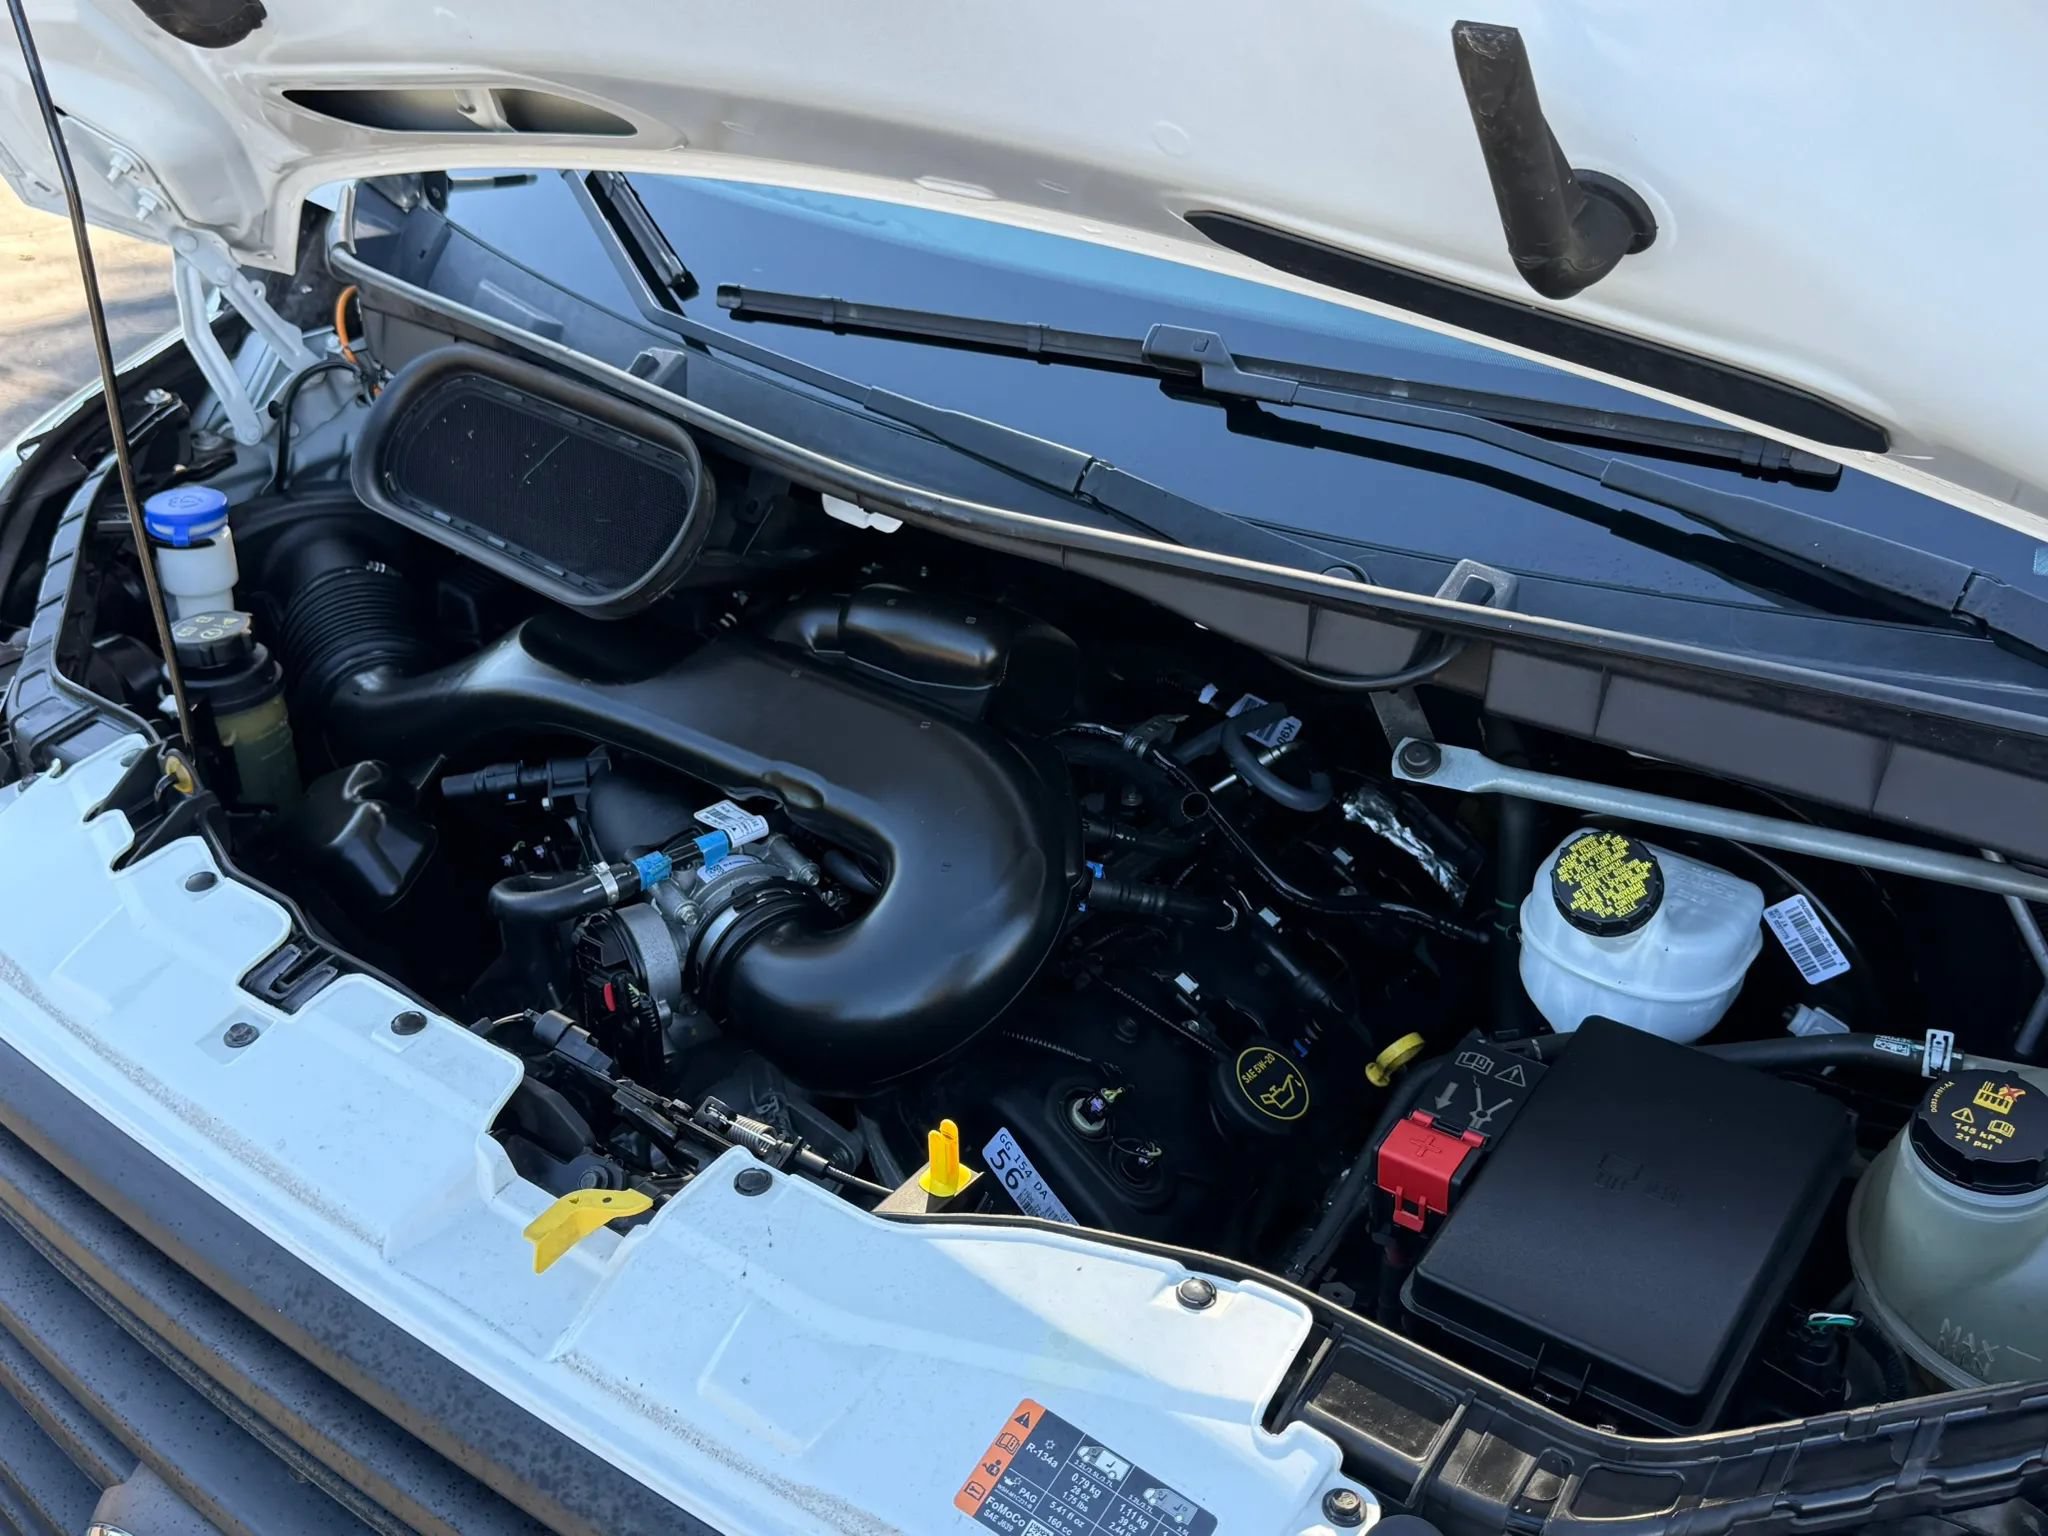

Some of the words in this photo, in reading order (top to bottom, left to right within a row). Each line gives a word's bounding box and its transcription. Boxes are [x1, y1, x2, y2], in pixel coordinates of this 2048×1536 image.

[1557, 860, 1579, 875] BEFORE
[1610, 836, 1623, 845] USE
[1559, 852, 1579, 865] CLEAN
[1579, 841, 1599, 854] FILLER
[1599, 833, 1612, 843] CAP
[1559, 871, 1575, 882] ONLY
[1575, 863, 1587, 873] DOT
[1594, 850, 1612, 862] FLUID
[1612, 840, 1630, 853] FROM
[1573, 867, 1596, 882] SEALED
[1616, 883, 1626, 891] DU
[1570, 896, 1589, 909] AVANT
[1589, 890, 1598, 898] DE
[1592, 903, 1605, 913] DOT
[1241, 1068, 1257, 1084] SAE
[1253, 1053, 1276, 1073] 5W-20
[1955, 1123, 1977, 1135] 145
[1979, 1131, 2003, 1144] kPa
[1955, 1132, 1970, 1142] 21
[1973, 1140, 1993, 1151] psi
[990, 1148, 1025, 1190] 56
[1000, 1133, 1013, 1151] GG
[1014, 1154, 1033, 1178] 154
[1033, 1181, 1048, 1200] DA
[1940, 1317, 1999, 1362] MAX
[1026, 1442, 1058, 1468] R-134a
[1018, 1487, 1038, 1503] PAG
[1070, 1485, 1081, 1495] 28
[1080, 1493, 1091, 1502] oz
[1071, 1473, 1090, 1489] 0.79
[1089, 1484, 1102, 1499] kg
[985, 1495, 1026, 1527] FoMoCo
[1062, 1491, 1077, 1505] 1.75
[1076, 1500, 1089, 1512] lbs
[1128, 1494, 1153, 1514] 3.2L/3.7L
[983, 1509, 999, 1522] SAE
[997, 1519, 1014, 1532] J639
[1047, 1515, 1062, 1528] 160
[1062, 1526, 1072, 1536] cc
[1049, 1501, 1066, 1516] 5.41
[1073, 1518, 1085, 1528] oz
[1118, 1516, 1129, 1526] 39
[1128, 1524, 1138, 1533] oz
[1120, 1503, 1137, 1520] 1.11
[1136, 1515, 1149, 1530] kg
[1108, 1522, 1126, 1536] 2.44
